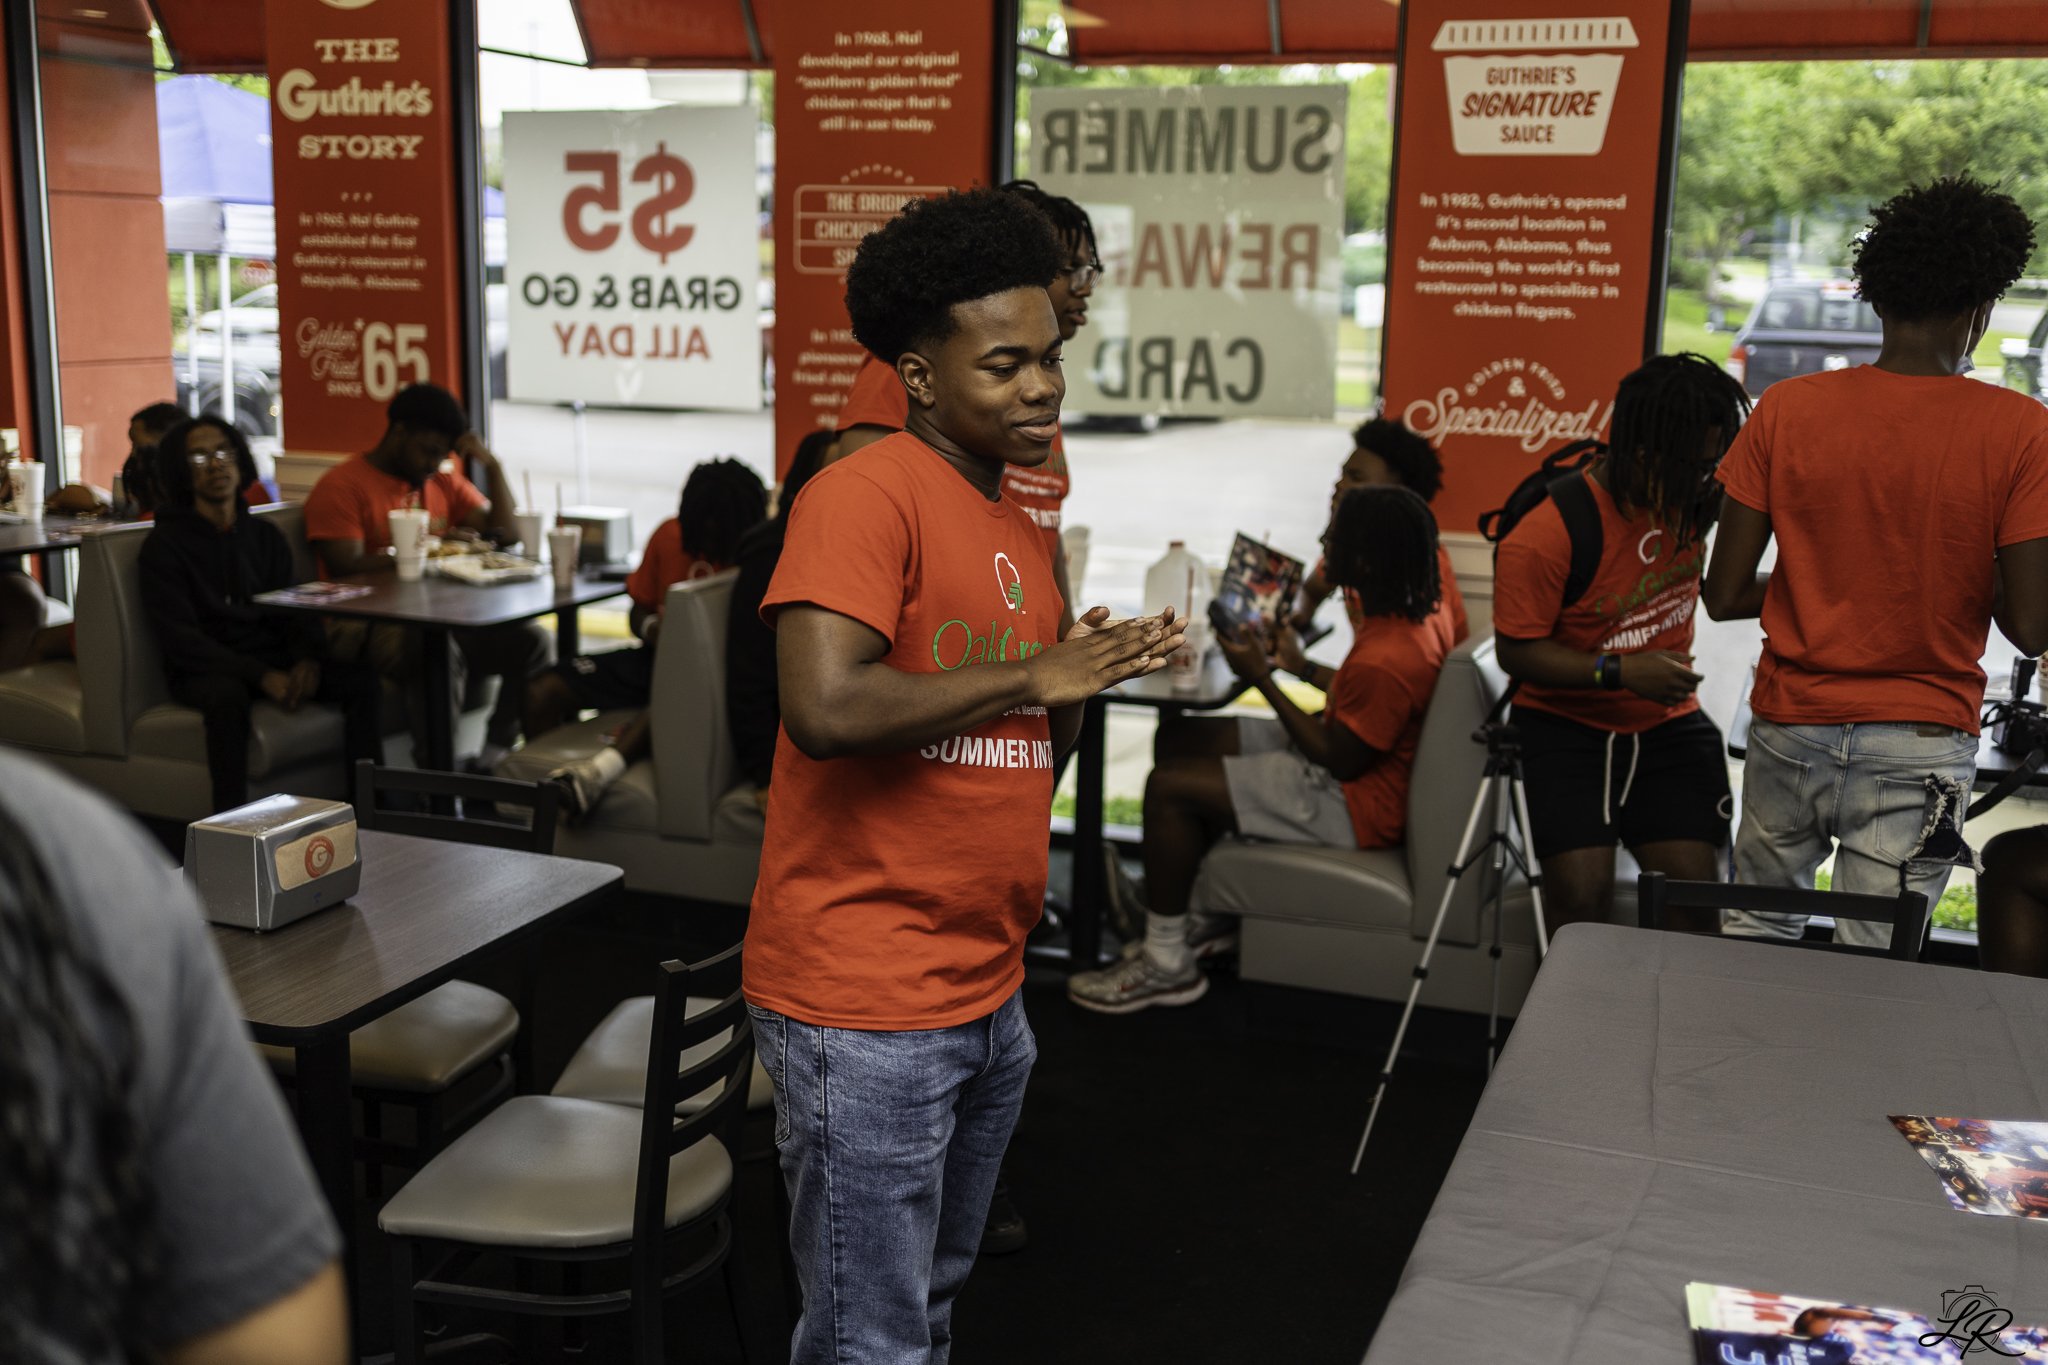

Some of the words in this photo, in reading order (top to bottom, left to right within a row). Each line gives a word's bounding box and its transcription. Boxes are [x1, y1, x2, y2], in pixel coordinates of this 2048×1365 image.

[314, 38, 400, 63] THE
[1487, 65, 1576, 85] GUTHRIE'S
[277, 68, 432, 122] Guthrie's
[1461, 91, 1602, 117] SIGNATURE
[1501, 124, 1556, 144] SAUCE
[298, 134, 424, 159] STORY
[826, 192, 855, 212] THE
[1419, 193, 1437, 208] In
[1488, 193, 1561, 209] Guthrie's
[1564, 193, 1628, 213] opened
[1436, 214, 1461, 230] it's
[1464, 214, 1519, 231] second
[1522, 215, 1586, 232] location
[1588, 216, 1607, 231] in
[1427, 236, 1492, 254] Auburn,
[1494, 236, 1573, 254] Alabama,
[1576, 237, 1612, 254] thus
[1417, 256, 1494, 277] becoming
[1497, 257, 1524, 274] the
[1526, 259, 1585, 276] world's
[1588, 259, 1621, 276] first
[1415, 279, 1497, 295] restaurant
[1501, 280, 1517, 296] to
[1520, 281, 1599, 299] specialize
[1602, 282, 1620, 298] in
[1453, 301, 1513, 318] chicken
[1515, 302, 1576, 322] fingers.
[1464, 357, 1526, 397] GOLDEN
[1528, 361, 1566, 400] FRIED
[1507, 376, 1526, 397] &
[1403, 387, 1615, 453] Specialized!
[920, 736, 1029, 769] SUMMER
